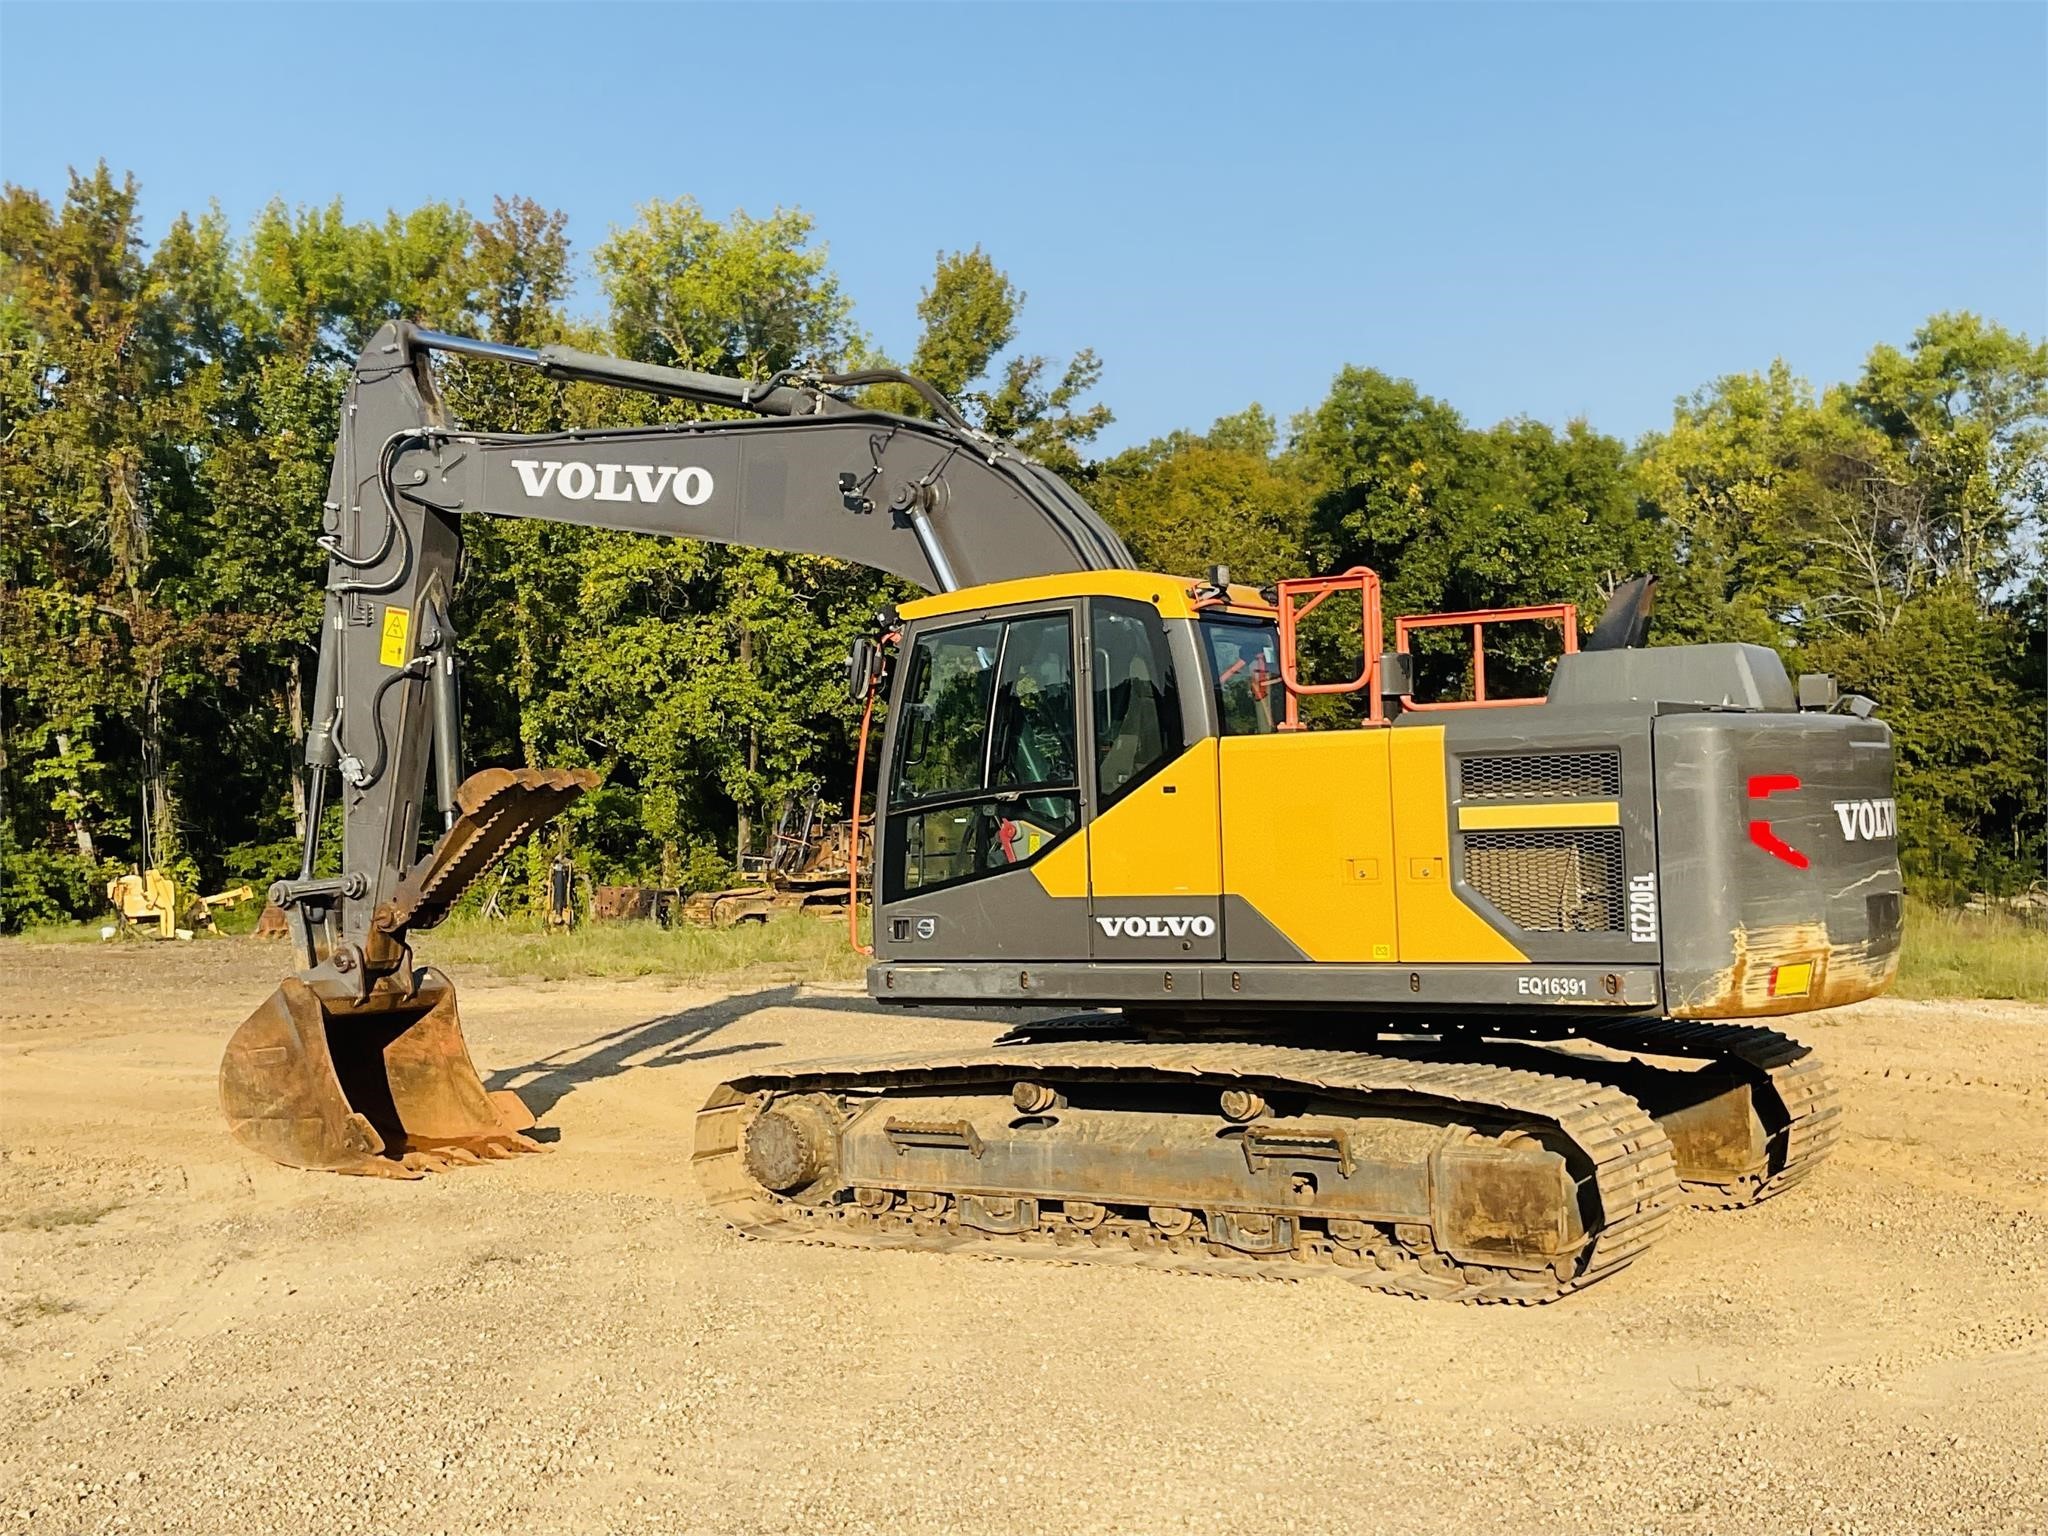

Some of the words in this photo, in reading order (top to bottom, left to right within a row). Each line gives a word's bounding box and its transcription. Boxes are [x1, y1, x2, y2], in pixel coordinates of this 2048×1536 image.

[511, 459, 714, 506] VOLVO
[1833, 798, 1898, 841] VOLV
[1095, 916, 1216, 937] VOLVO
[1629, 872, 1656, 942] EC220EL
[1518, 977, 1587, 995] EQ16391
